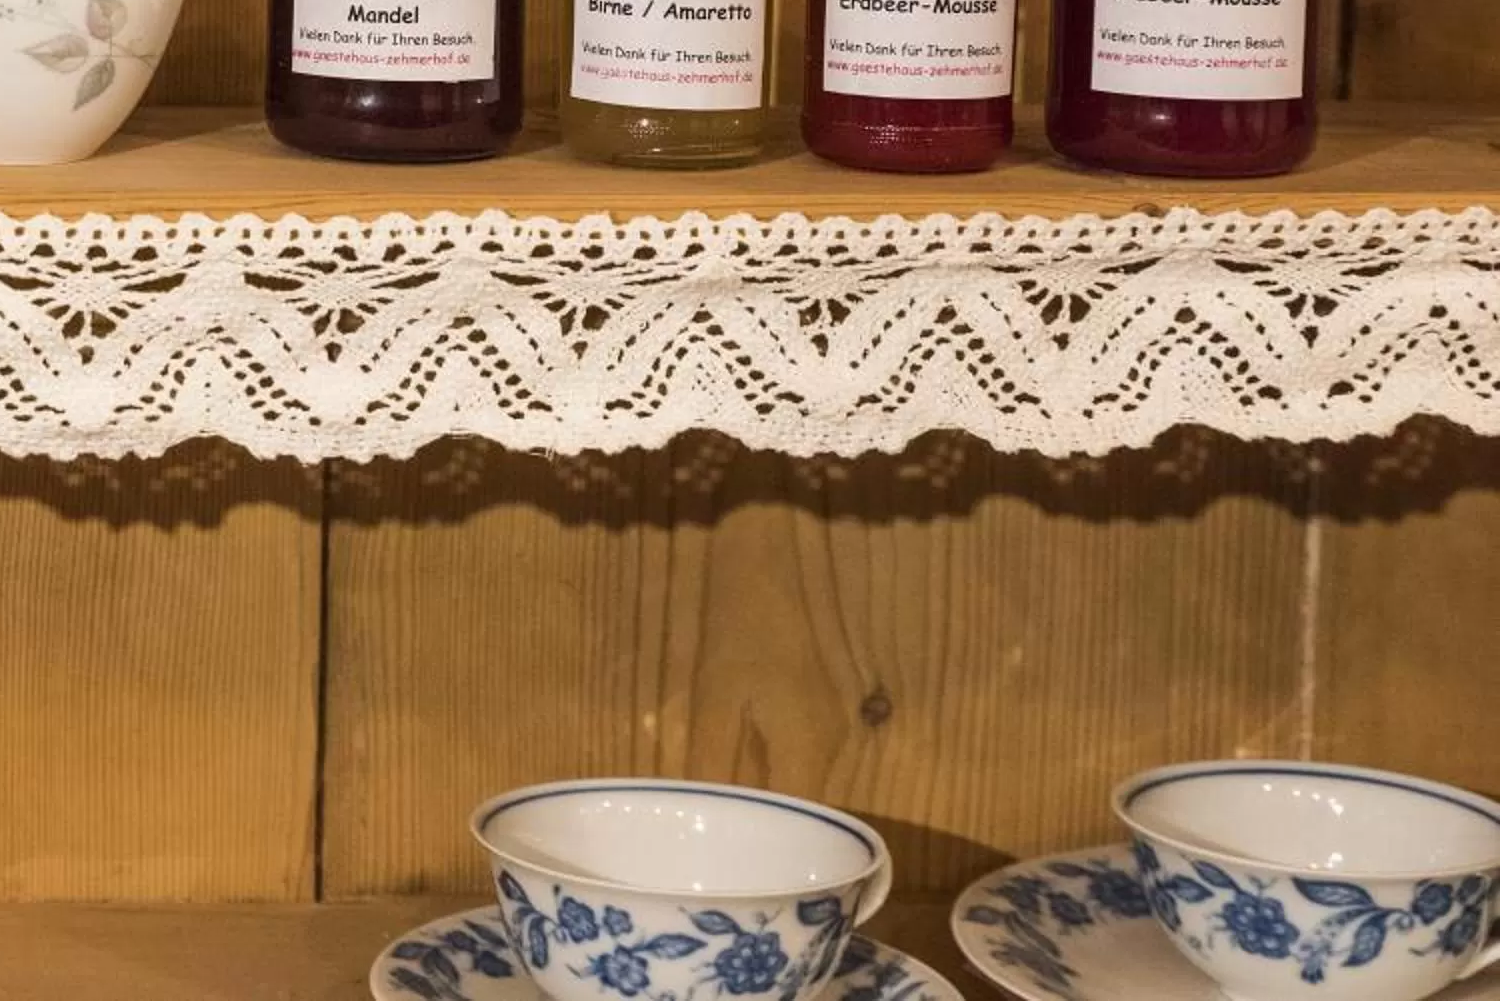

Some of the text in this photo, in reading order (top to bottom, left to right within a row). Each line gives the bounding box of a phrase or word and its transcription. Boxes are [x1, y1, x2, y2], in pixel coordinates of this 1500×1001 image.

[347, 4, 420, 25] Mandel
[642, 0, 655, 18] /
[663, 2, 753, 21] Amaretto
[299, 27, 332, 42] Vielen
[333, 30, 363, 45] Dank
[367, 30, 389, 46] für
[392, 32, 429, 47] Ihren
[1099, 28, 1136, 43] Vielen
[1139, 32, 1173, 46] Dank
[1177, 33, 1199, 48] für
[1203, 35, 1241, 49] Ihren
[581, 40, 613, 57] Vielen
[615, 46, 645, 60] Dank
[650, 48, 671, 63] für
[675, 50, 713, 64] Ihren
[829, 38, 863, 53] Vielen
[865, 42, 897, 56] Dank
[901, 42, 923, 58] für
[927, 43, 964, 58] Ihren
